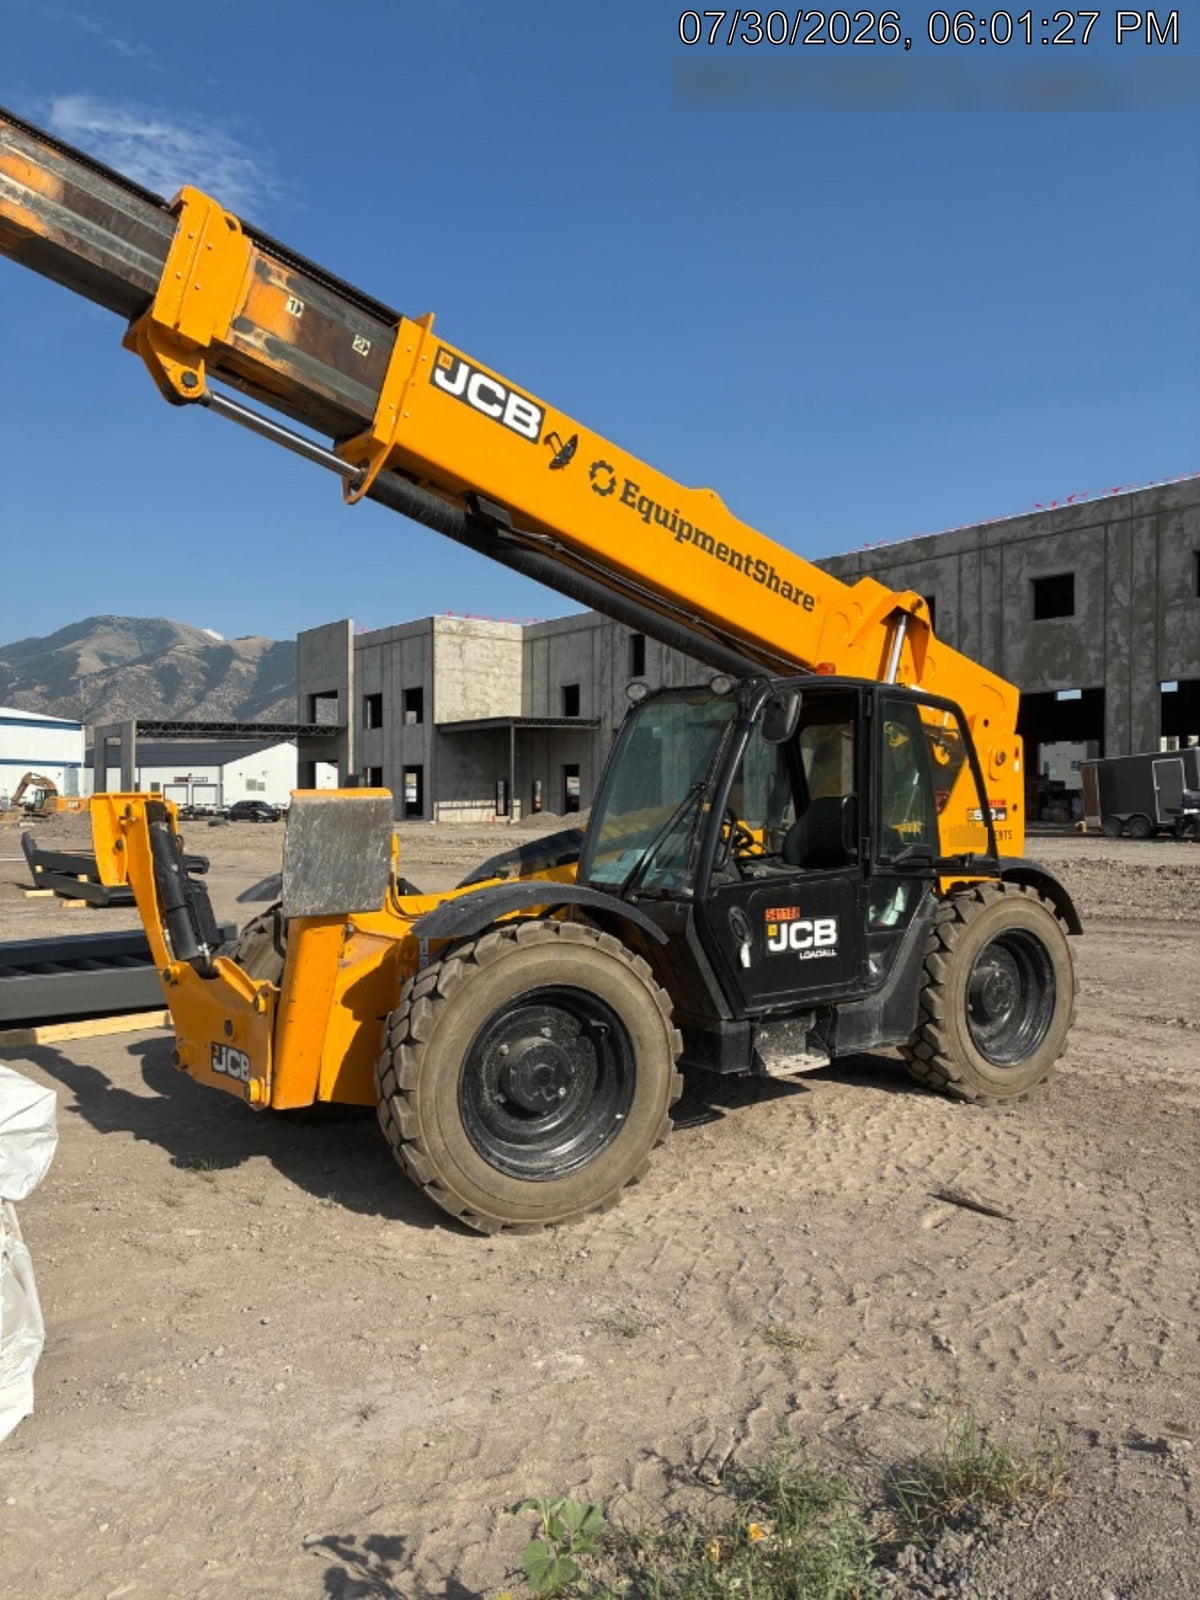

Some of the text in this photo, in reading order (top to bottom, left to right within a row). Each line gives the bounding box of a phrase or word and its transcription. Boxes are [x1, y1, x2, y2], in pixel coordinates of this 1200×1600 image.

[434, 361, 542, 440] JCB
[619, 478, 815, 612] EquipmentShare
[994, 829, 1013, 842] ENTS
[767, 919, 837, 952] JCB
[799, 948, 837, 960] LOADALL
[212, 1046, 250, 1082] JCB
